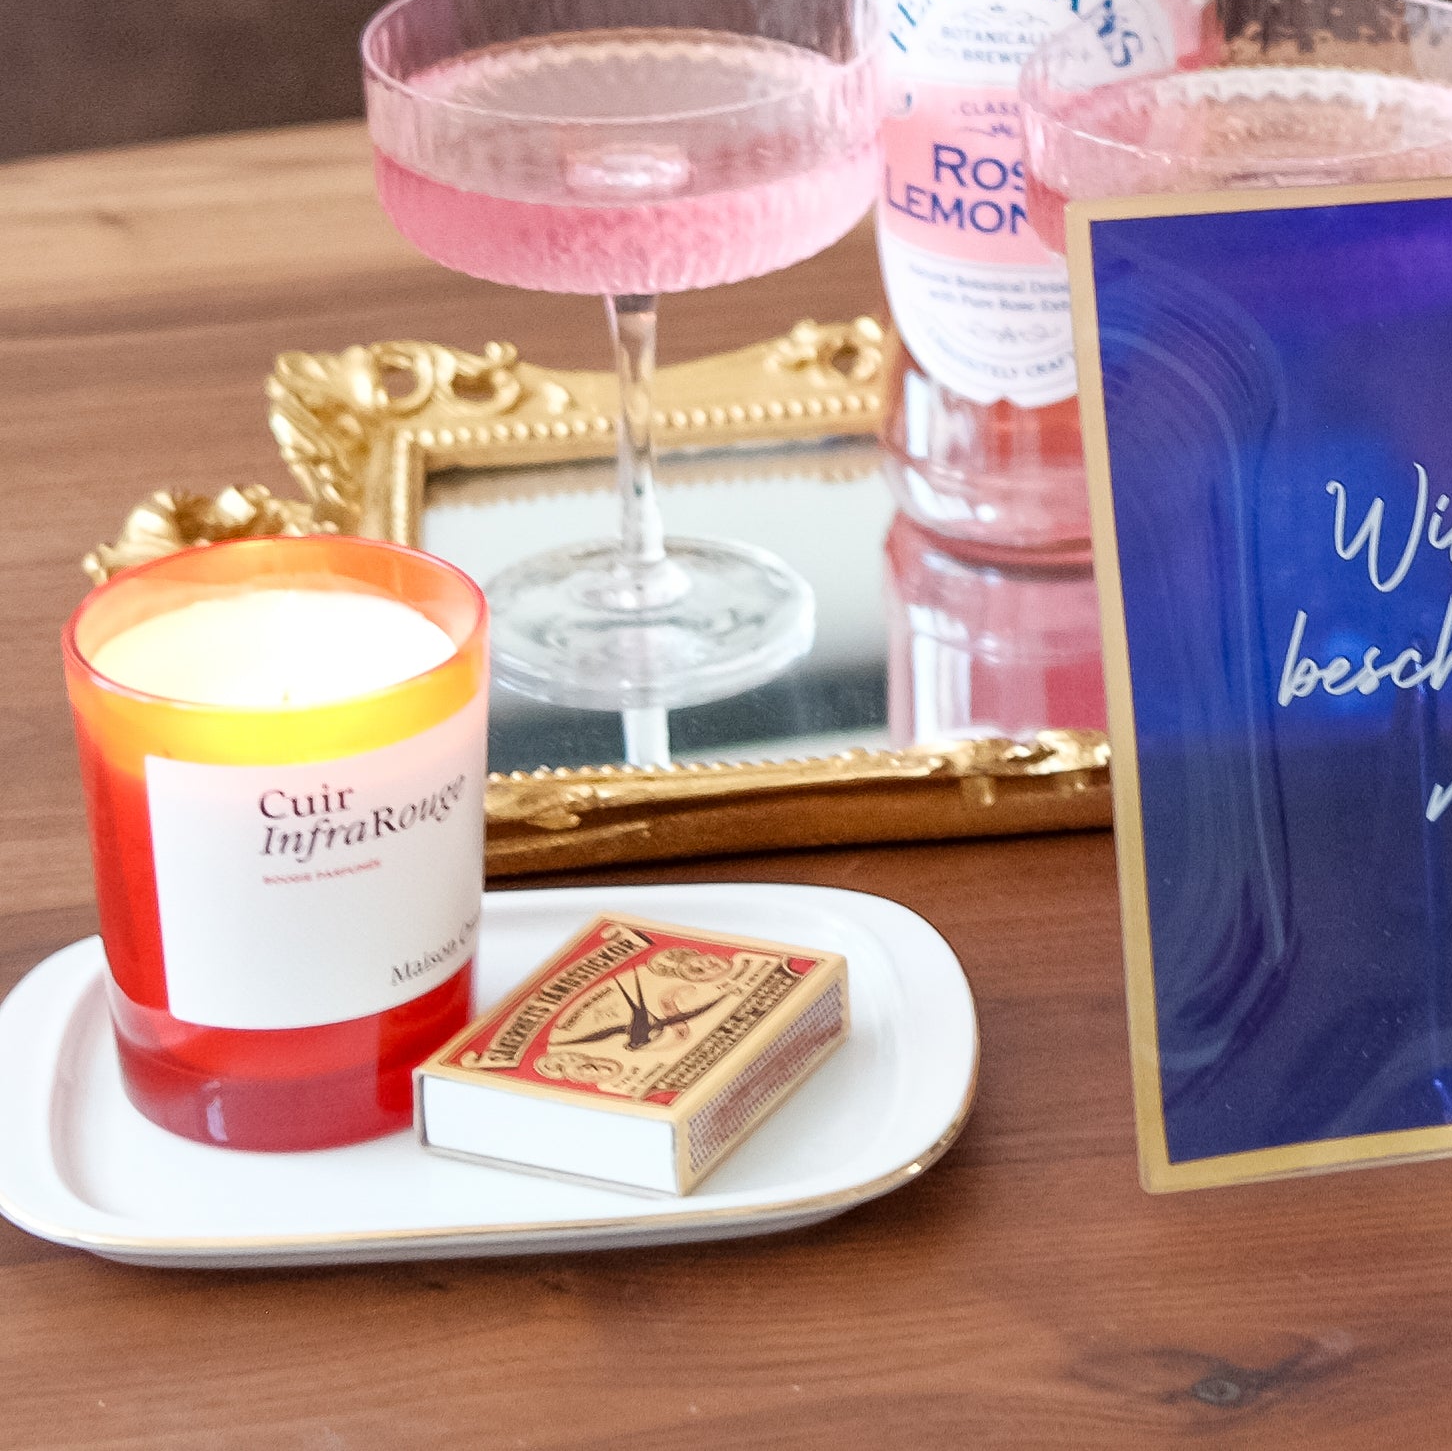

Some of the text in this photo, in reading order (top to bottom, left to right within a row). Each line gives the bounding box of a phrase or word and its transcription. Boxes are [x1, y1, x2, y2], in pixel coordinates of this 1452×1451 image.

[933, 141, 1025, 193] ROS
[886, 163, 1027, 234] LEMON
[259, 782, 355, 820] Cuir
[259, 773, 466, 864] InfraRouge
